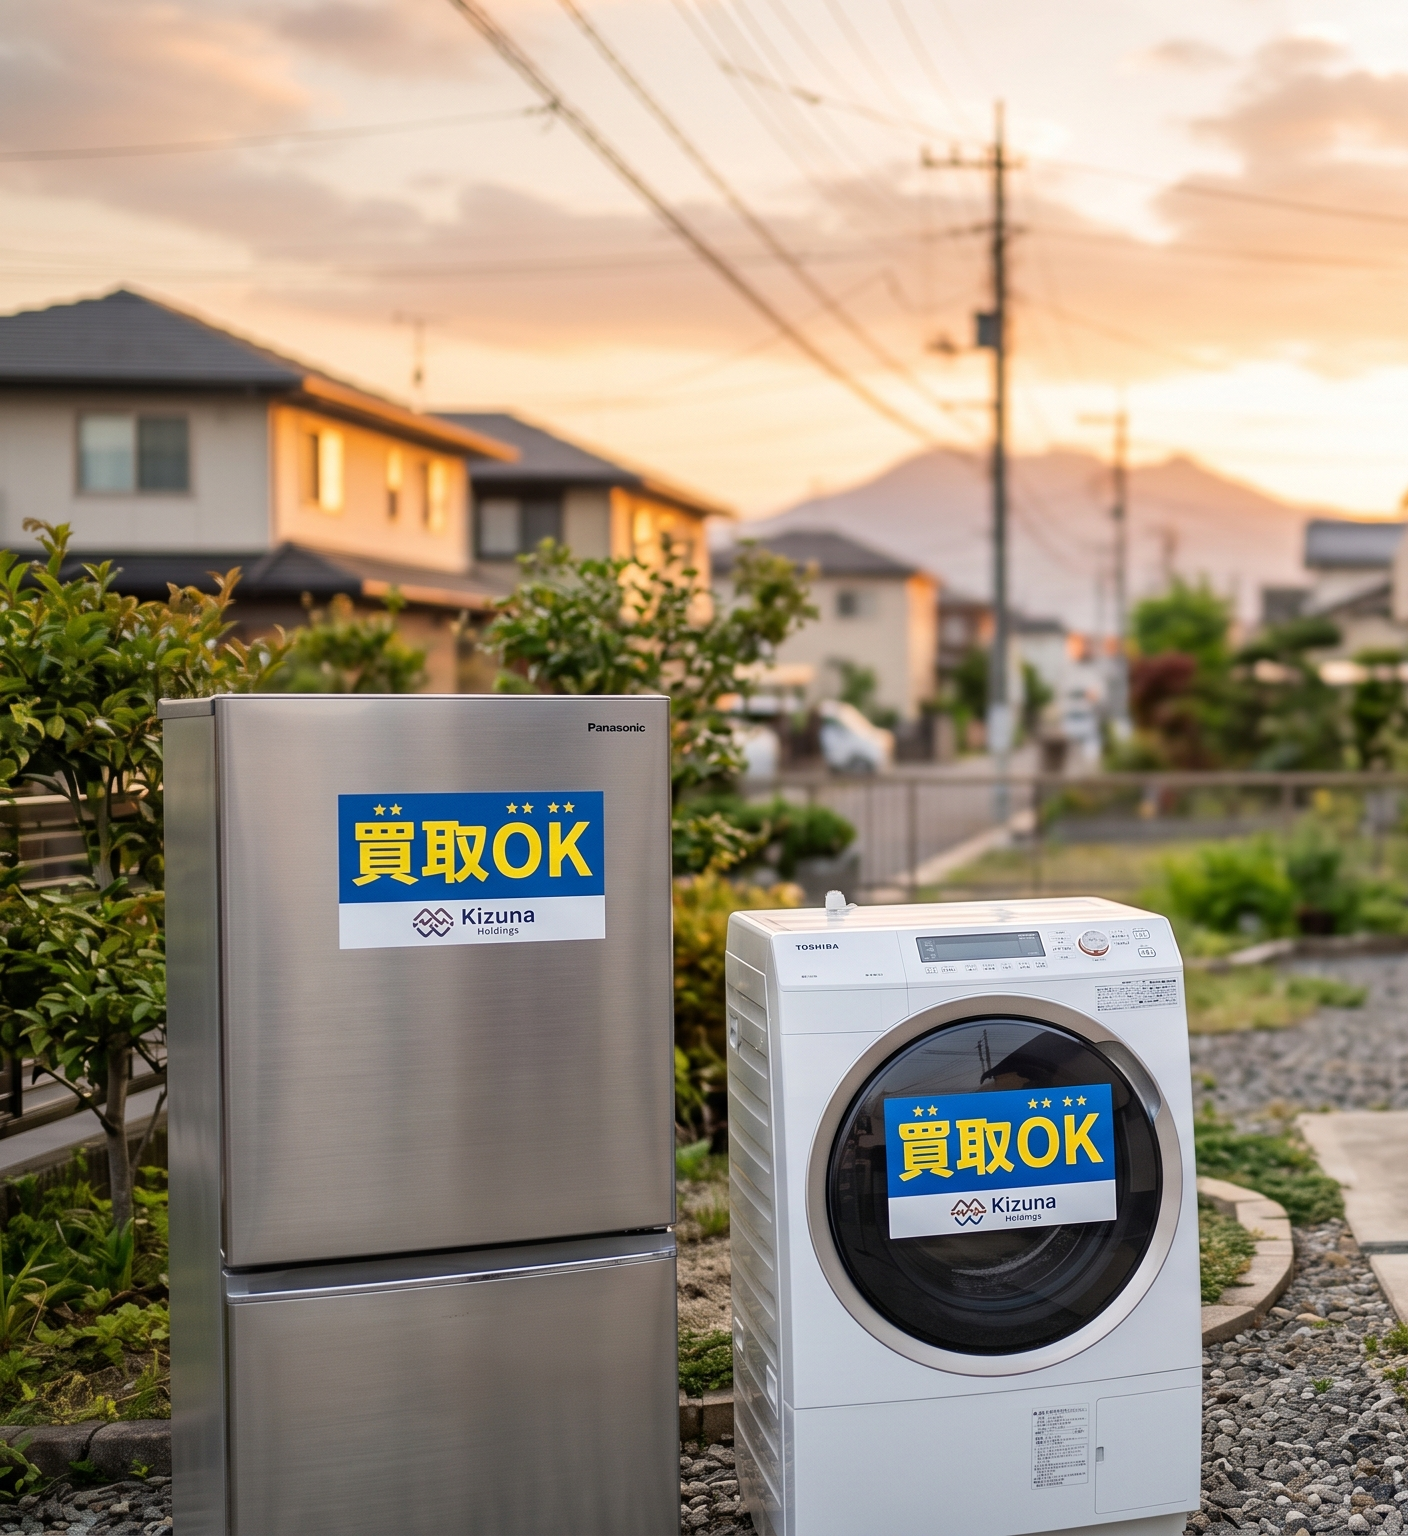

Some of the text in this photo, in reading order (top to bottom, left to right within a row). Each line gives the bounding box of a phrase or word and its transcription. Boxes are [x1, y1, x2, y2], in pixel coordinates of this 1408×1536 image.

[587, 722, 646, 732] Panasonic
[352, 820, 594, 887] 買取OK
[461, 907, 535, 925] Kizuna
[477, 926, 520, 936] Holdings
[795, 943, 840, 951] TOSHIBA
[898, 1113, 1104, 1182] 買取OK
[992, 1196, 1056, 1213] Kizuna
